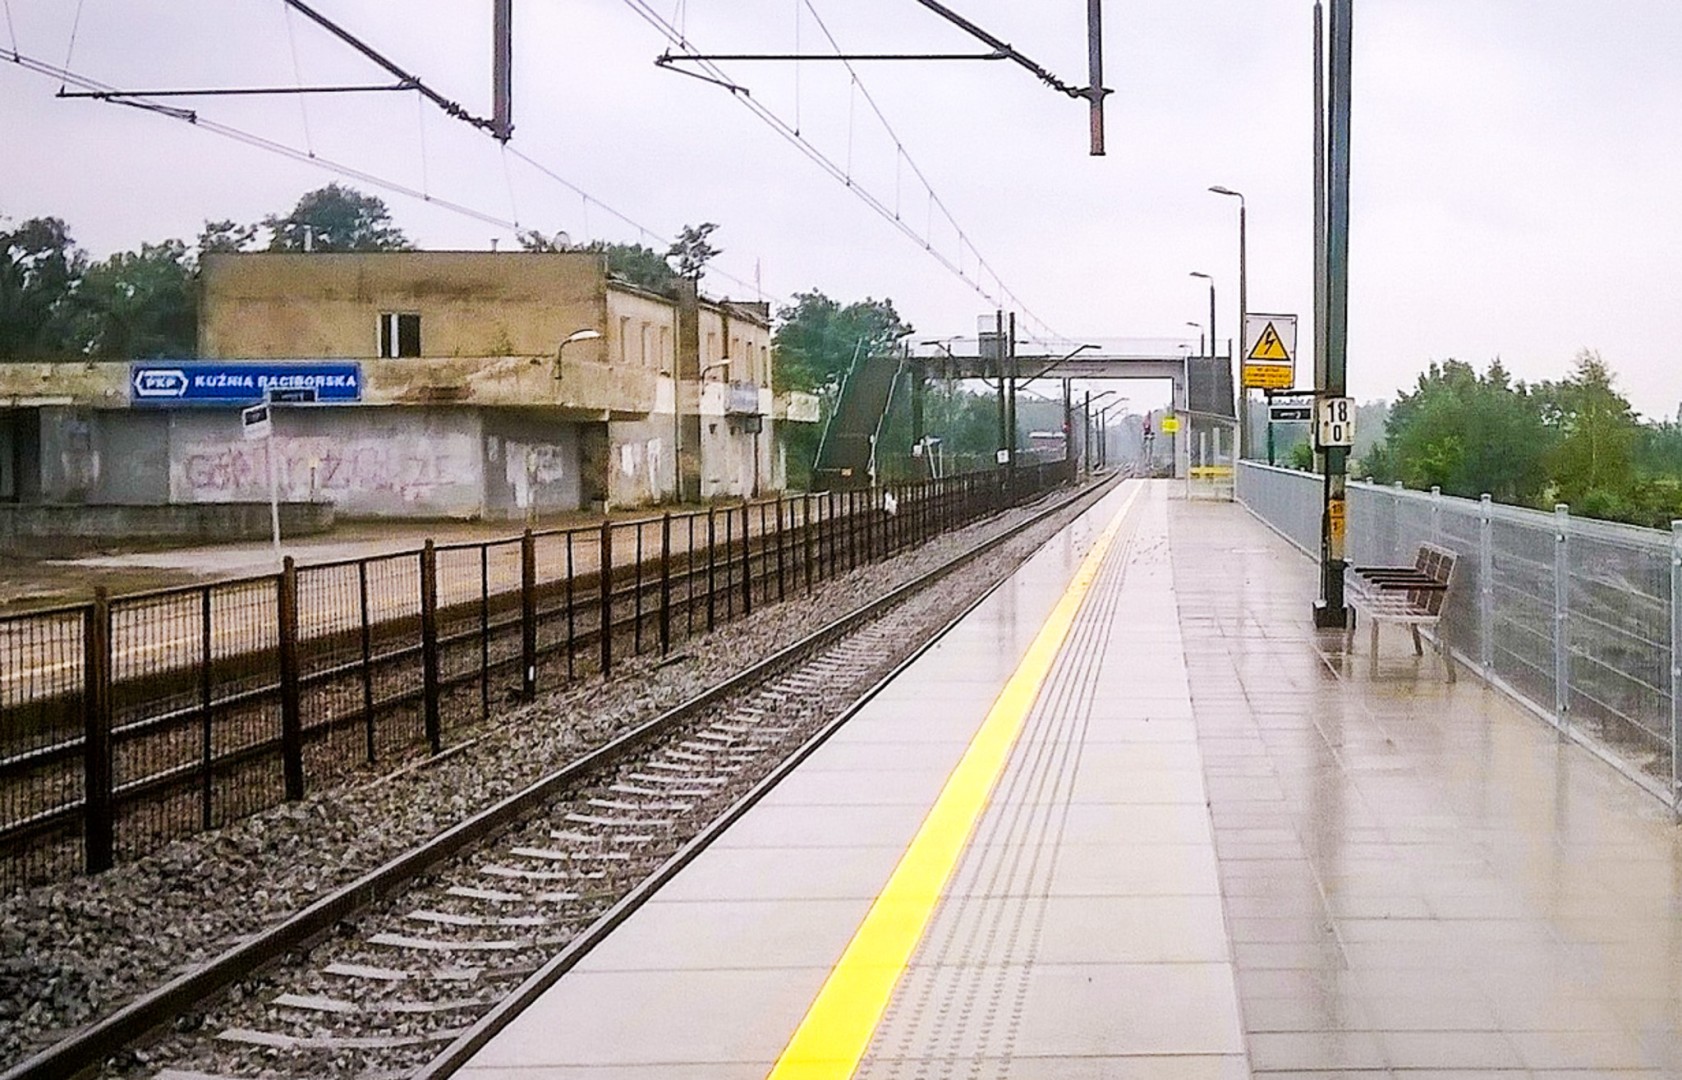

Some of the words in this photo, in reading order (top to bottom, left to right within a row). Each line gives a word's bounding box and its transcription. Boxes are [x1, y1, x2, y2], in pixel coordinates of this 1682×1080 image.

[145, 378, 176, 388] PKP
[194, 373, 254, 388] KUŹNIA
[257, 375, 357, 388] RACIBORSKA
[1327, 401, 1347, 423] 18
[1333, 424, 1342, 442] 0
